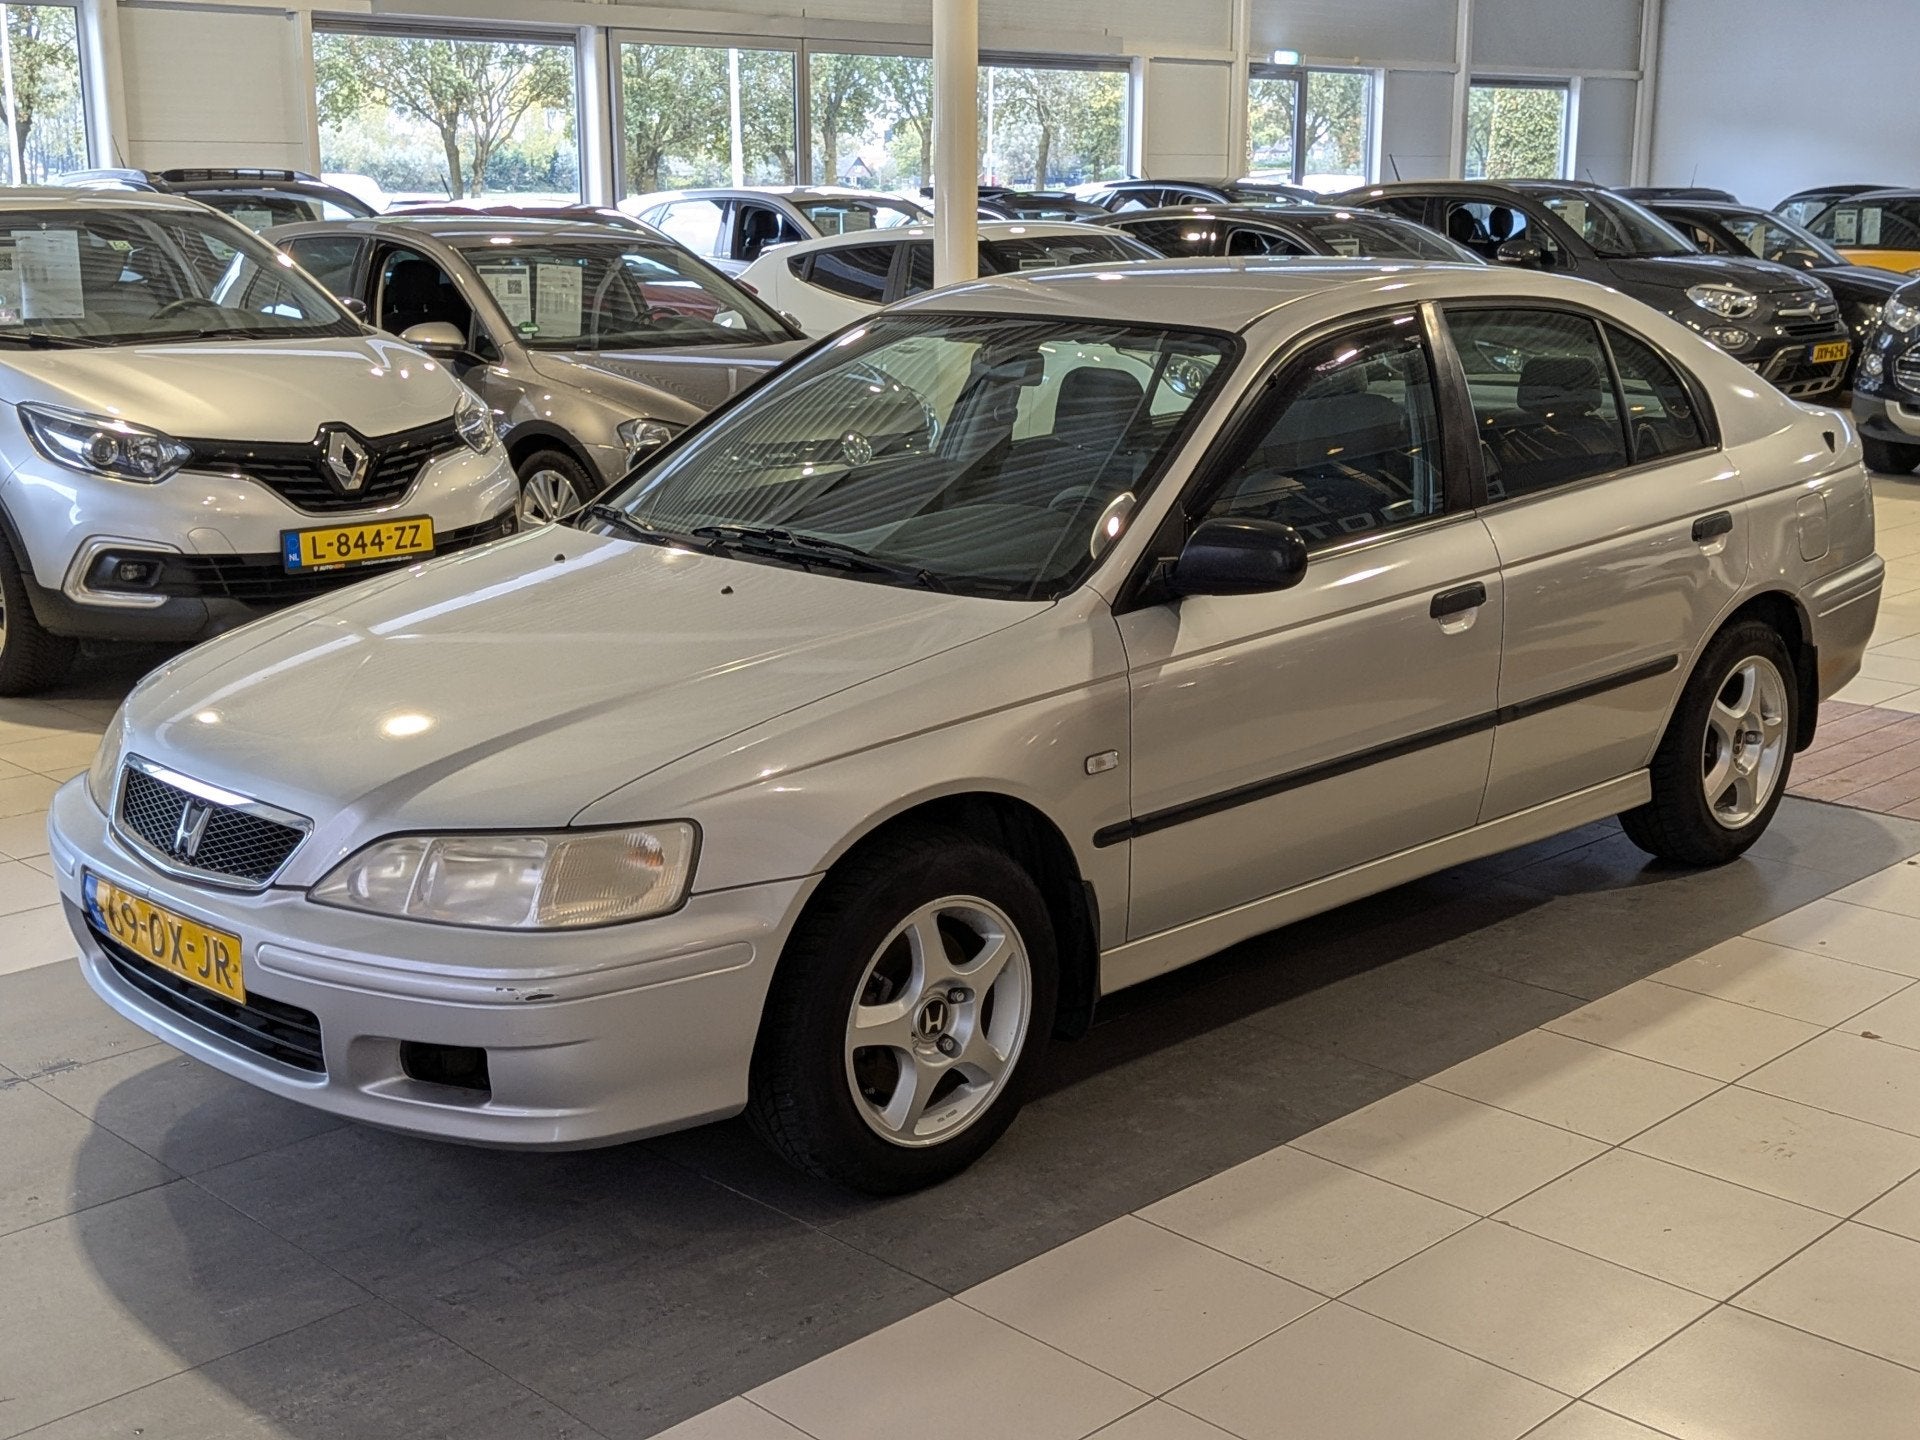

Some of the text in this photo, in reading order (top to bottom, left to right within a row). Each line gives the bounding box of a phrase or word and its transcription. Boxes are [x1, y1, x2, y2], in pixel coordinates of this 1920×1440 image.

[288, 553, 300, 562] NL
[311, 524, 422, 559] L-844-ZZ
[108, 889, 234, 990] 69-DX-JR
